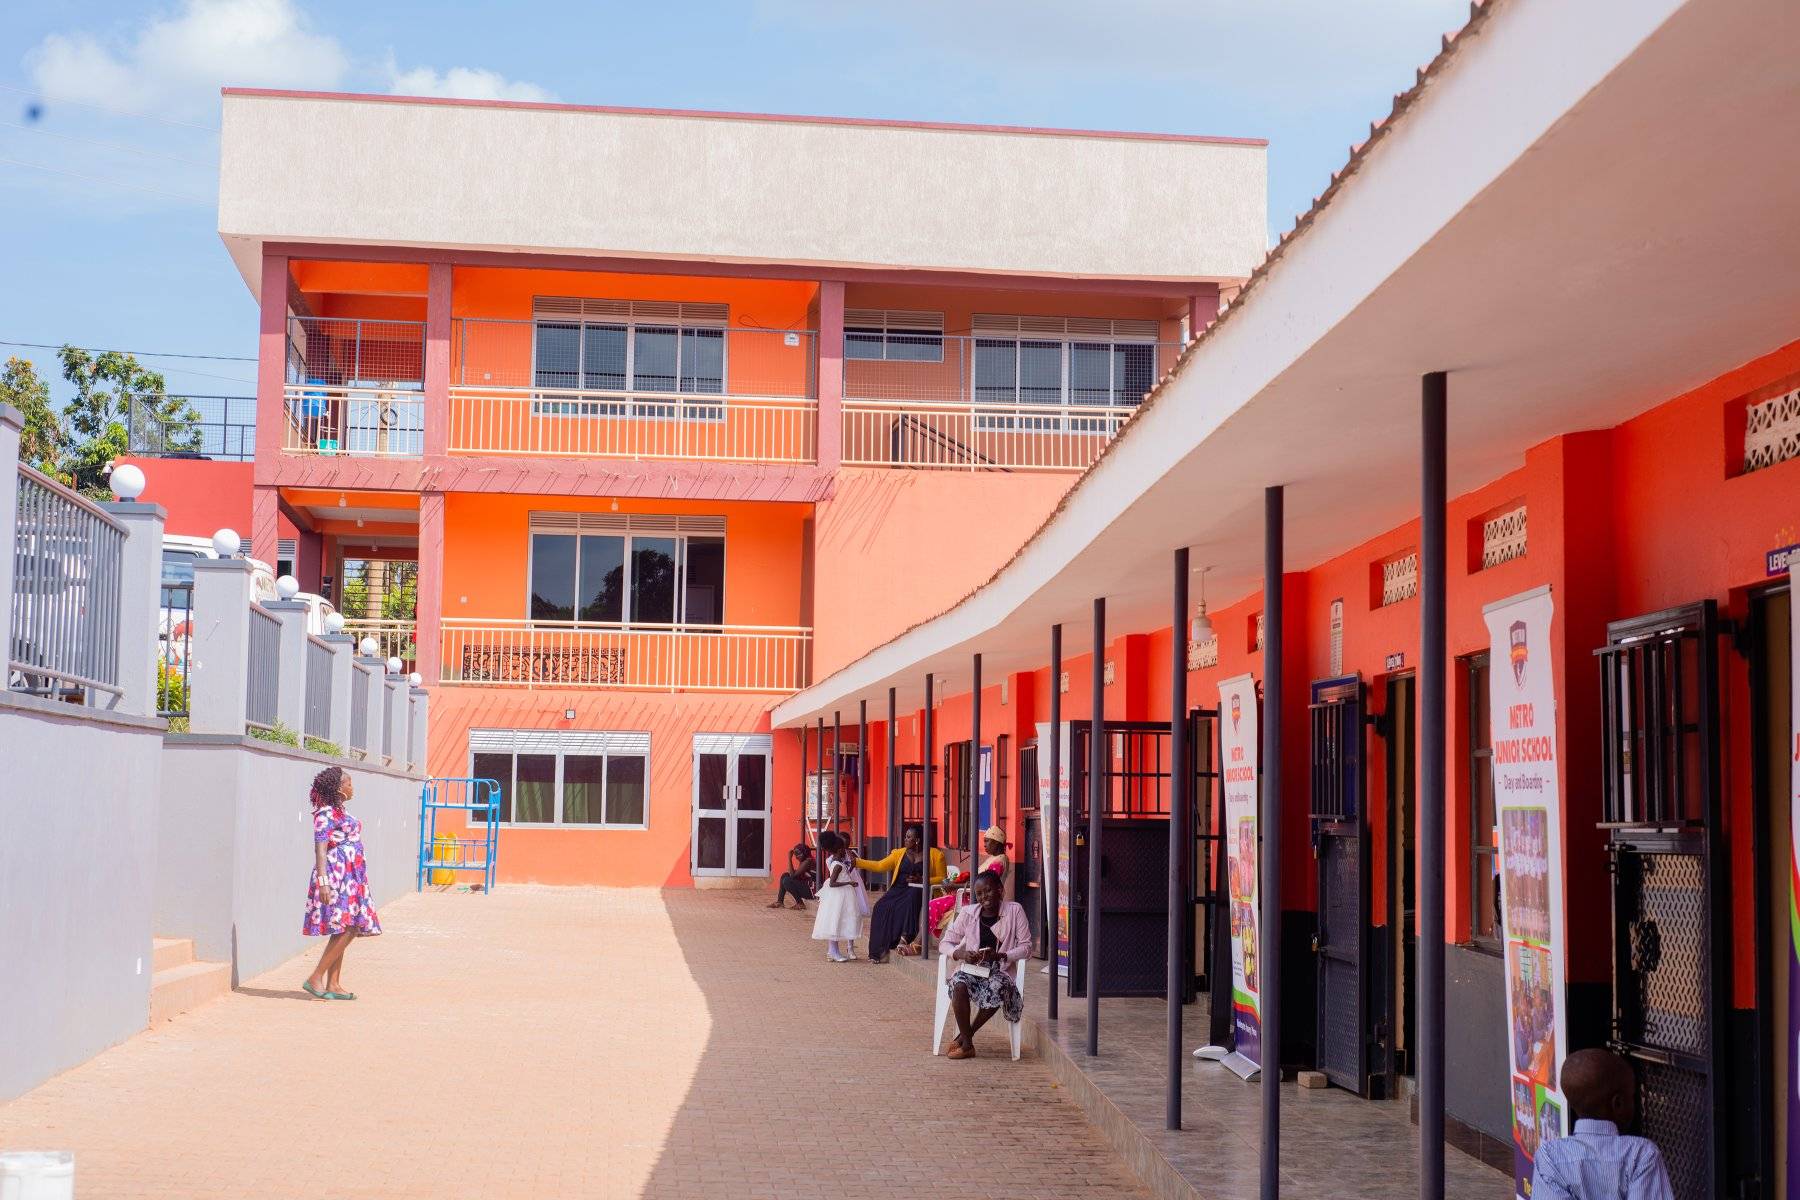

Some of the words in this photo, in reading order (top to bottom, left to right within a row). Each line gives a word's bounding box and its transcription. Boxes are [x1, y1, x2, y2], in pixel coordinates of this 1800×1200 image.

[1509, 703, 1534, 729] METRO
[1495, 740, 1520, 765] JUNIOR
[1521, 736, 1553, 762] SCHOOL
